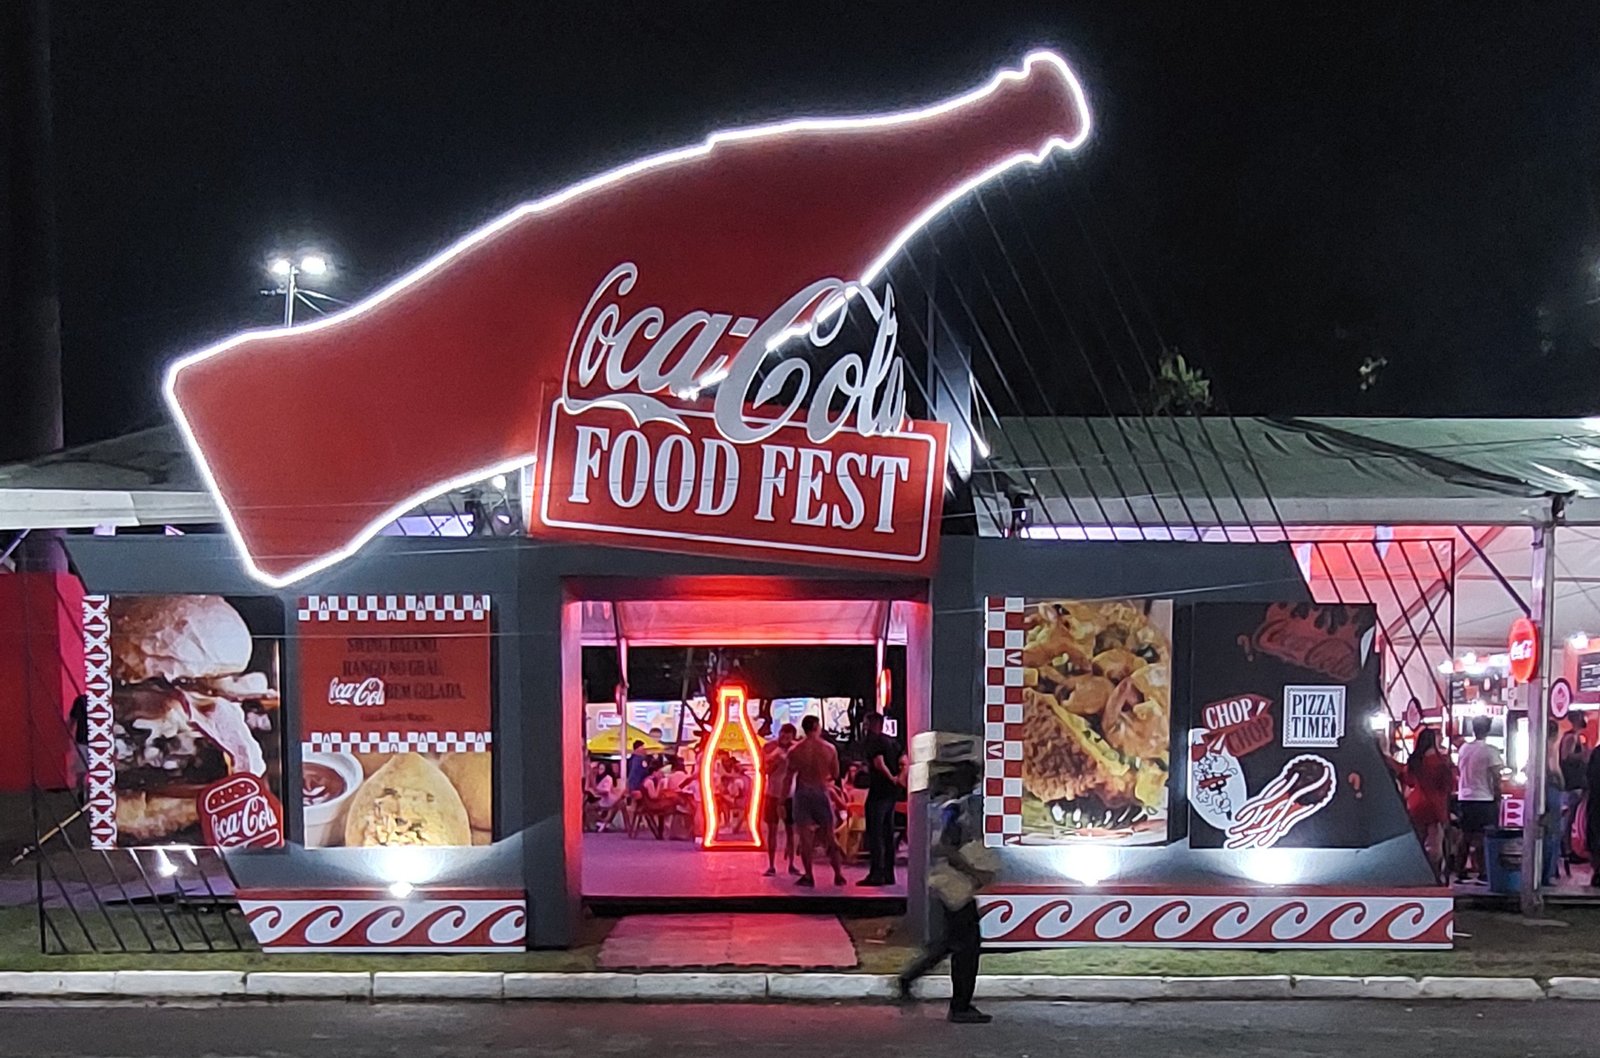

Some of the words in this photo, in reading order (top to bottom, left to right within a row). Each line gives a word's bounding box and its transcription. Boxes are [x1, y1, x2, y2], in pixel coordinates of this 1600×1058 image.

[568, 425, 740, 517] FOOD
[754, 443, 910, 534] FEST
[1292, 693, 1337, 716] PIZZA
